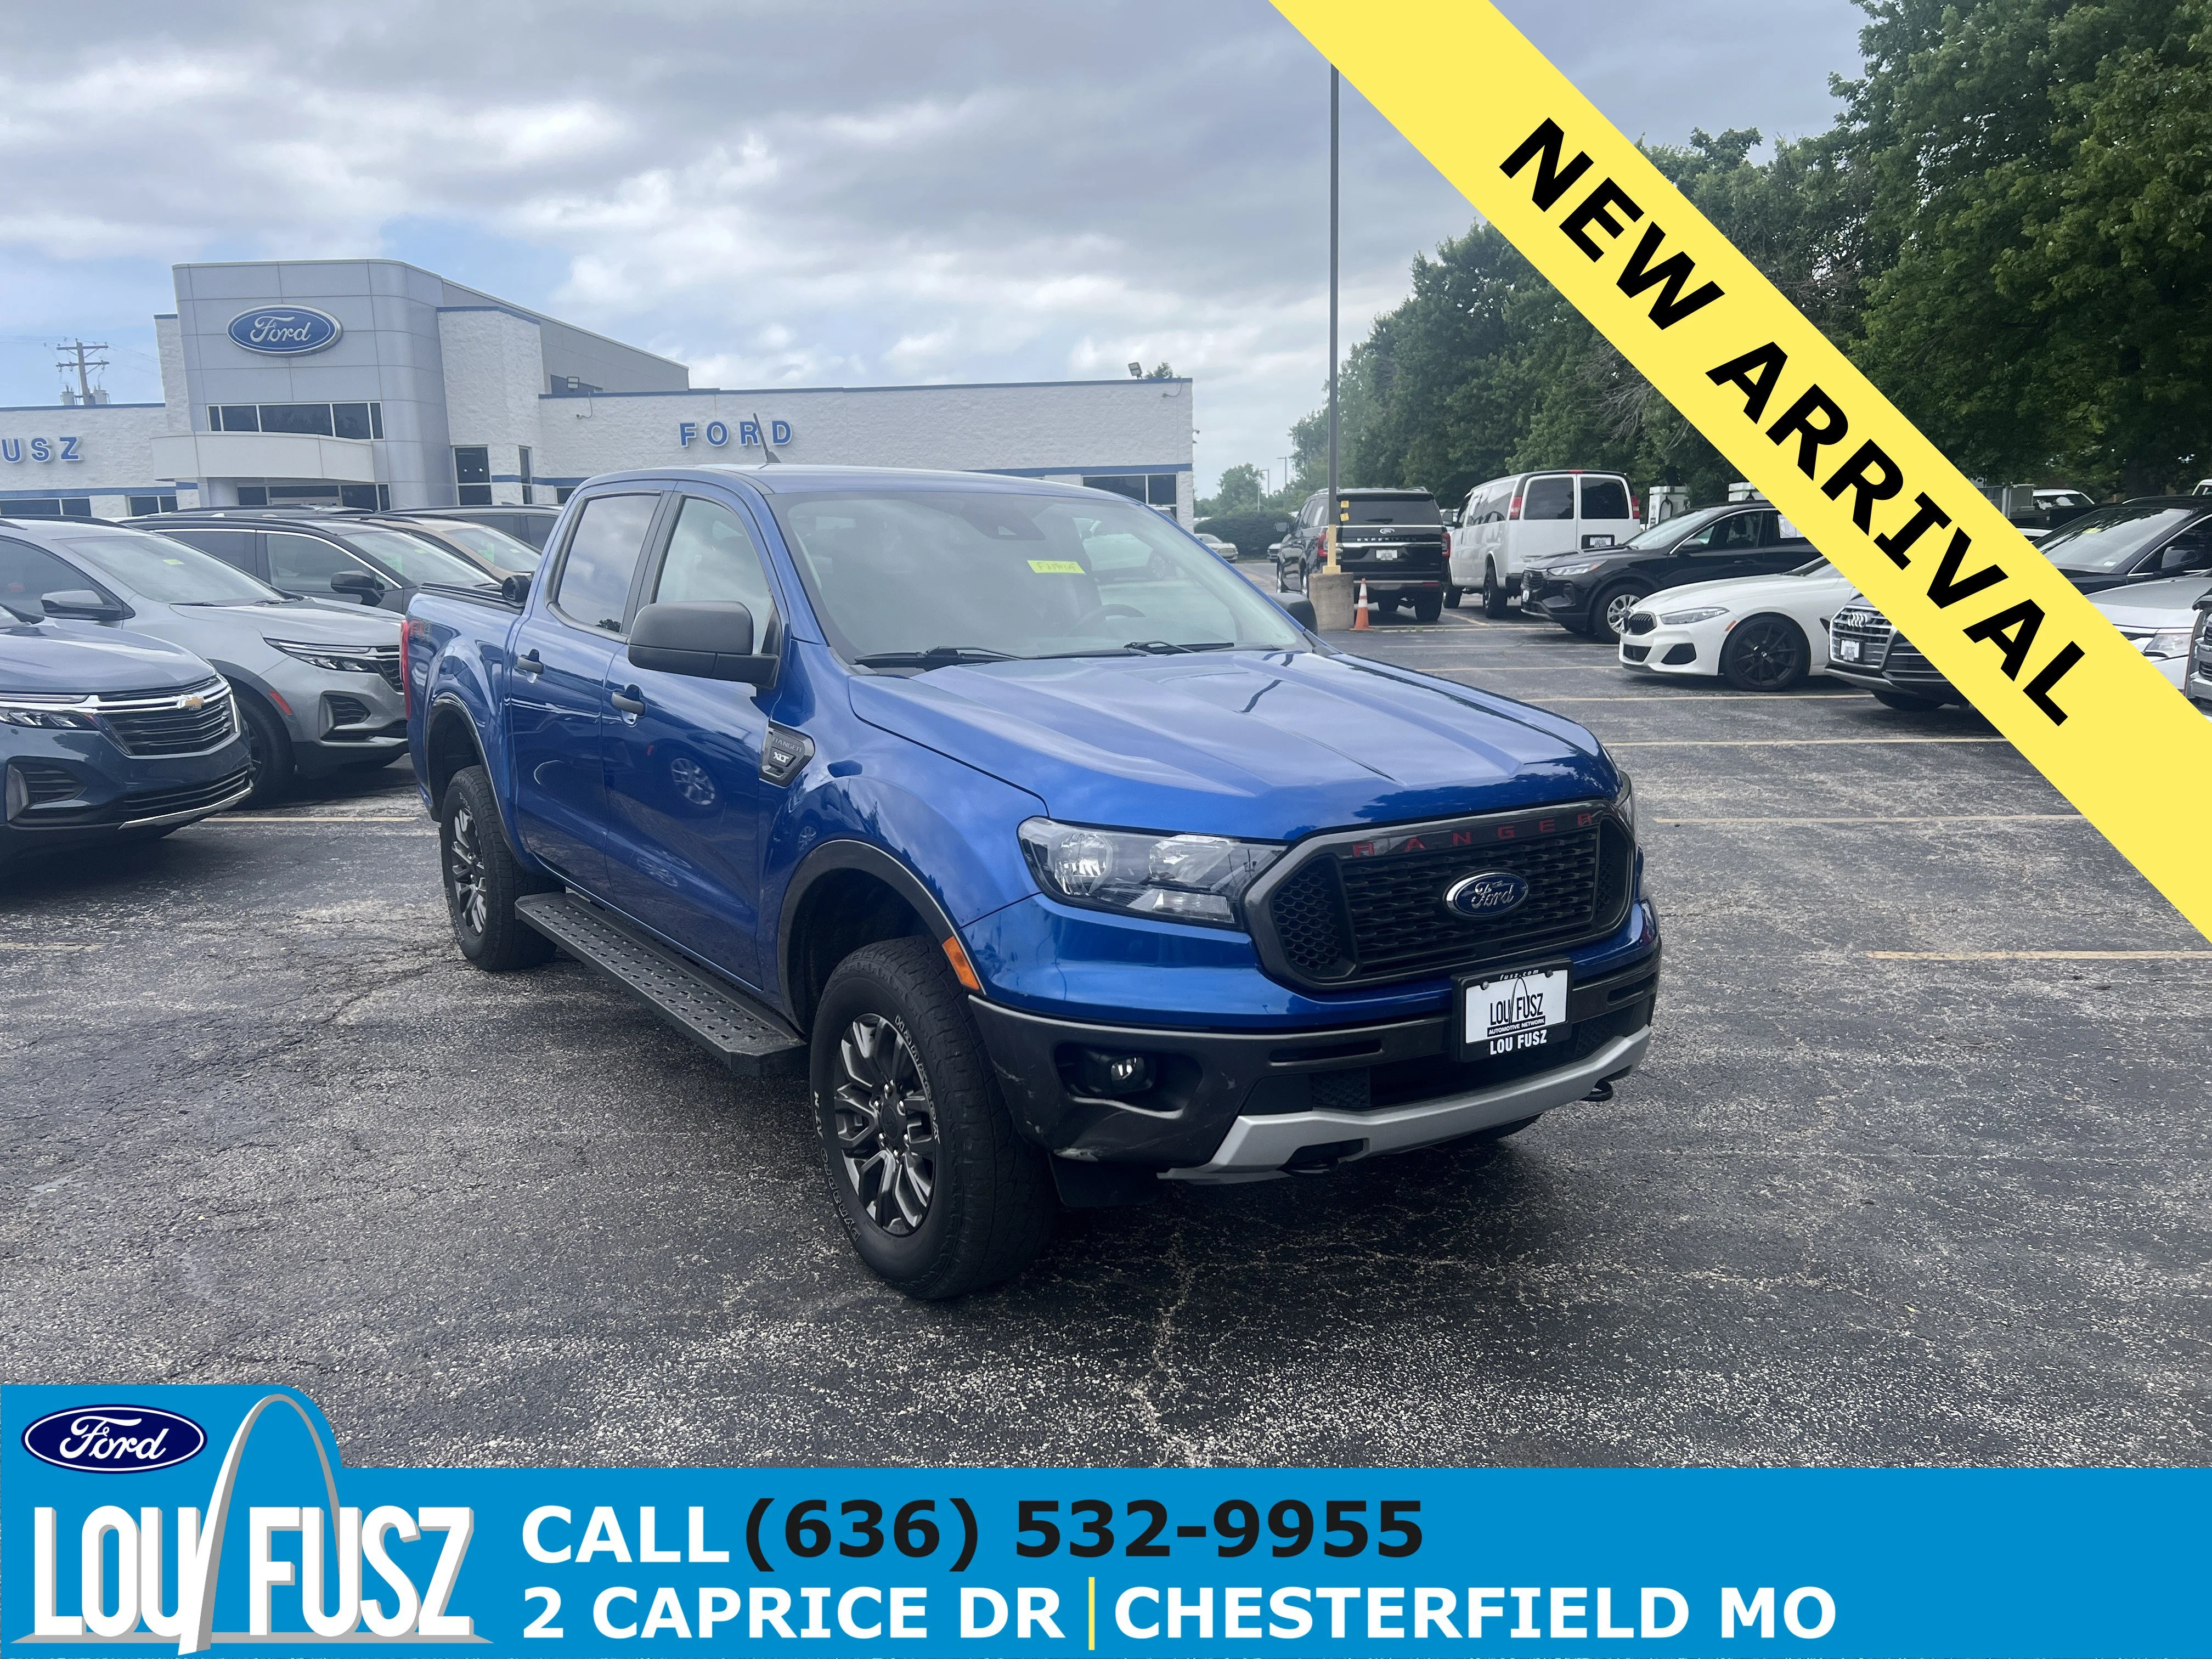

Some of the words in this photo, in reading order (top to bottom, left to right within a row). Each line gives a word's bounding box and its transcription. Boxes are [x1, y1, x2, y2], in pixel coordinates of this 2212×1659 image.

[250, 315, 311, 343] Ford
[680, 420, 792, 447] FORD
[772, 737, 803, 753] RANGER
[772, 752, 789, 763] XLT
[1352, 814, 1592, 857] RANGER
[1471, 881, 1515, 909] Ford
[1499, 969, 1539, 981] fusz.com
[1490, 999, 1511, 1026] LOU
[1516, 992, 1543, 1020] FUSZ
[1488, 1023, 1520, 1035] AUTOMOTIVE
[1521, 1018, 1545, 1028] NETWORK
[1489, 1037, 1513, 1055] LOU
[1517, 1029, 1547, 1049] FUSZ
